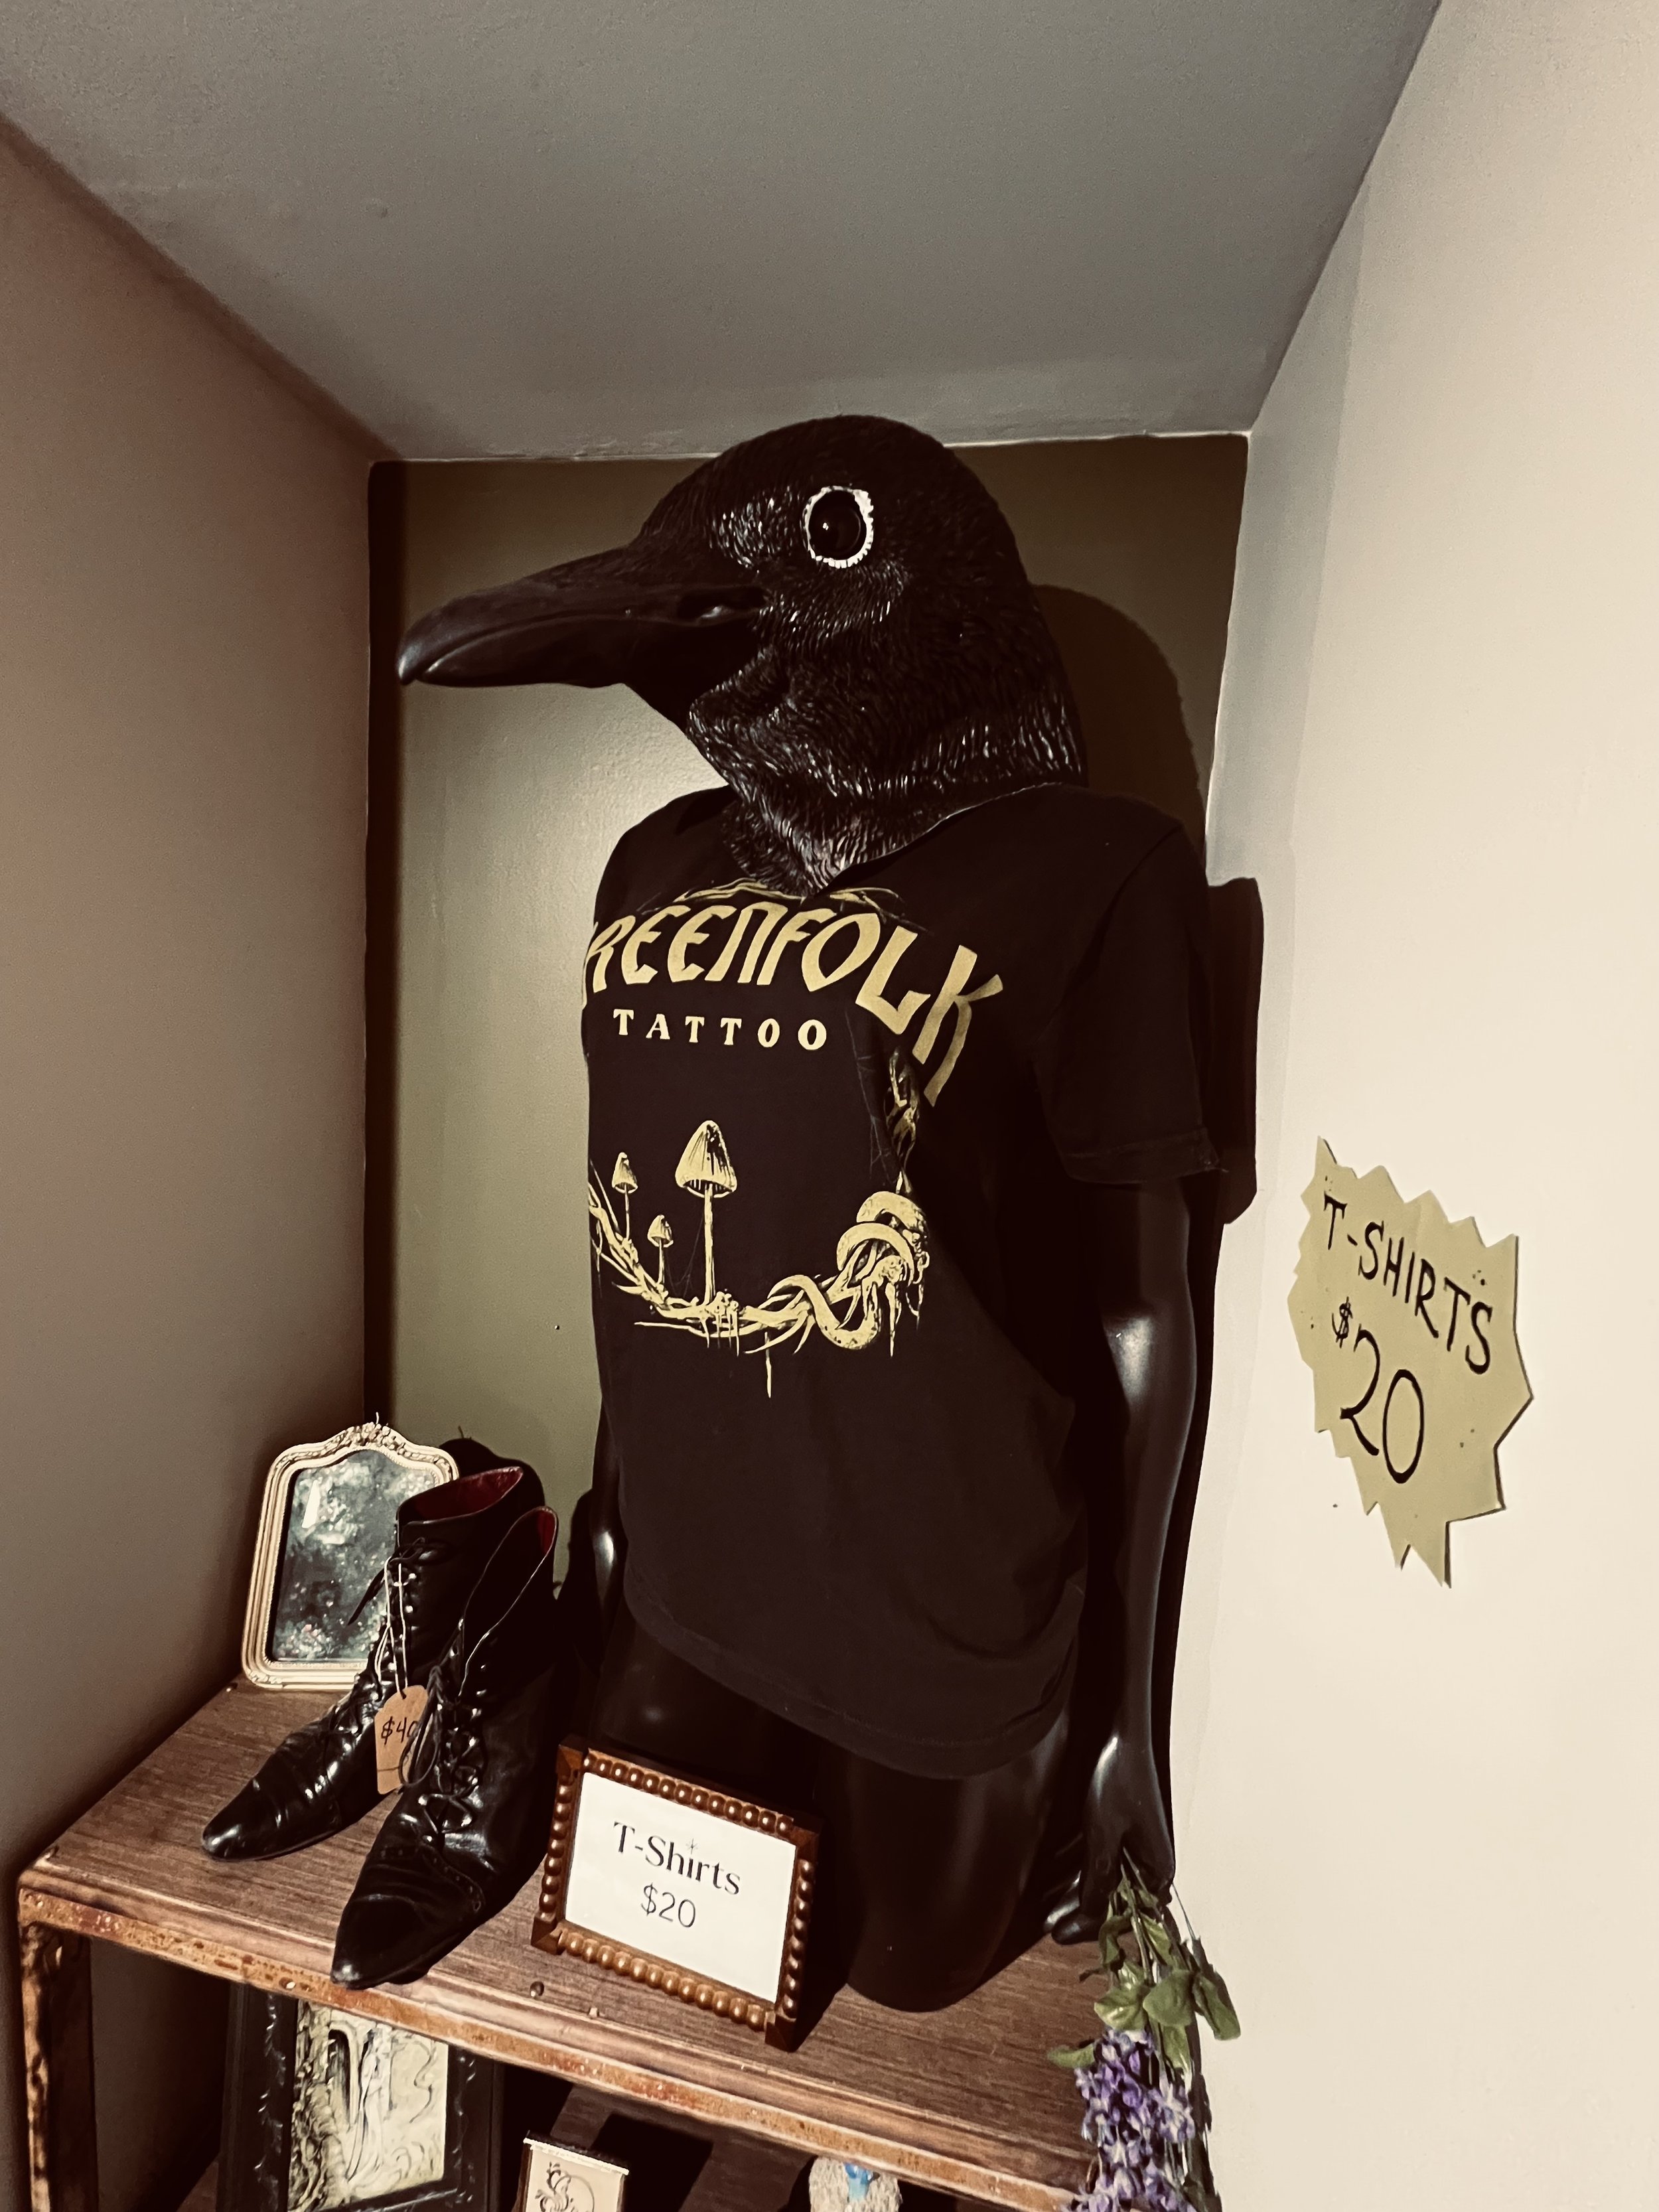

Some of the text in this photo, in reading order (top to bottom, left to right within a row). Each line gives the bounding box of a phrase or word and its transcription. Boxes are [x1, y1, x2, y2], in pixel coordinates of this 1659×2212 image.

[582, 901, 1003, 1107] REENFOLK
[613, 1009, 827, 1051] TATTOO
[1324, 1192, 1492, 1374] T-SHIRTS
[1331, 1296, 1425, 1483] $20
[613, 1821, 741, 1895] T-Shirts
[640, 1883, 697, 1928] $20
